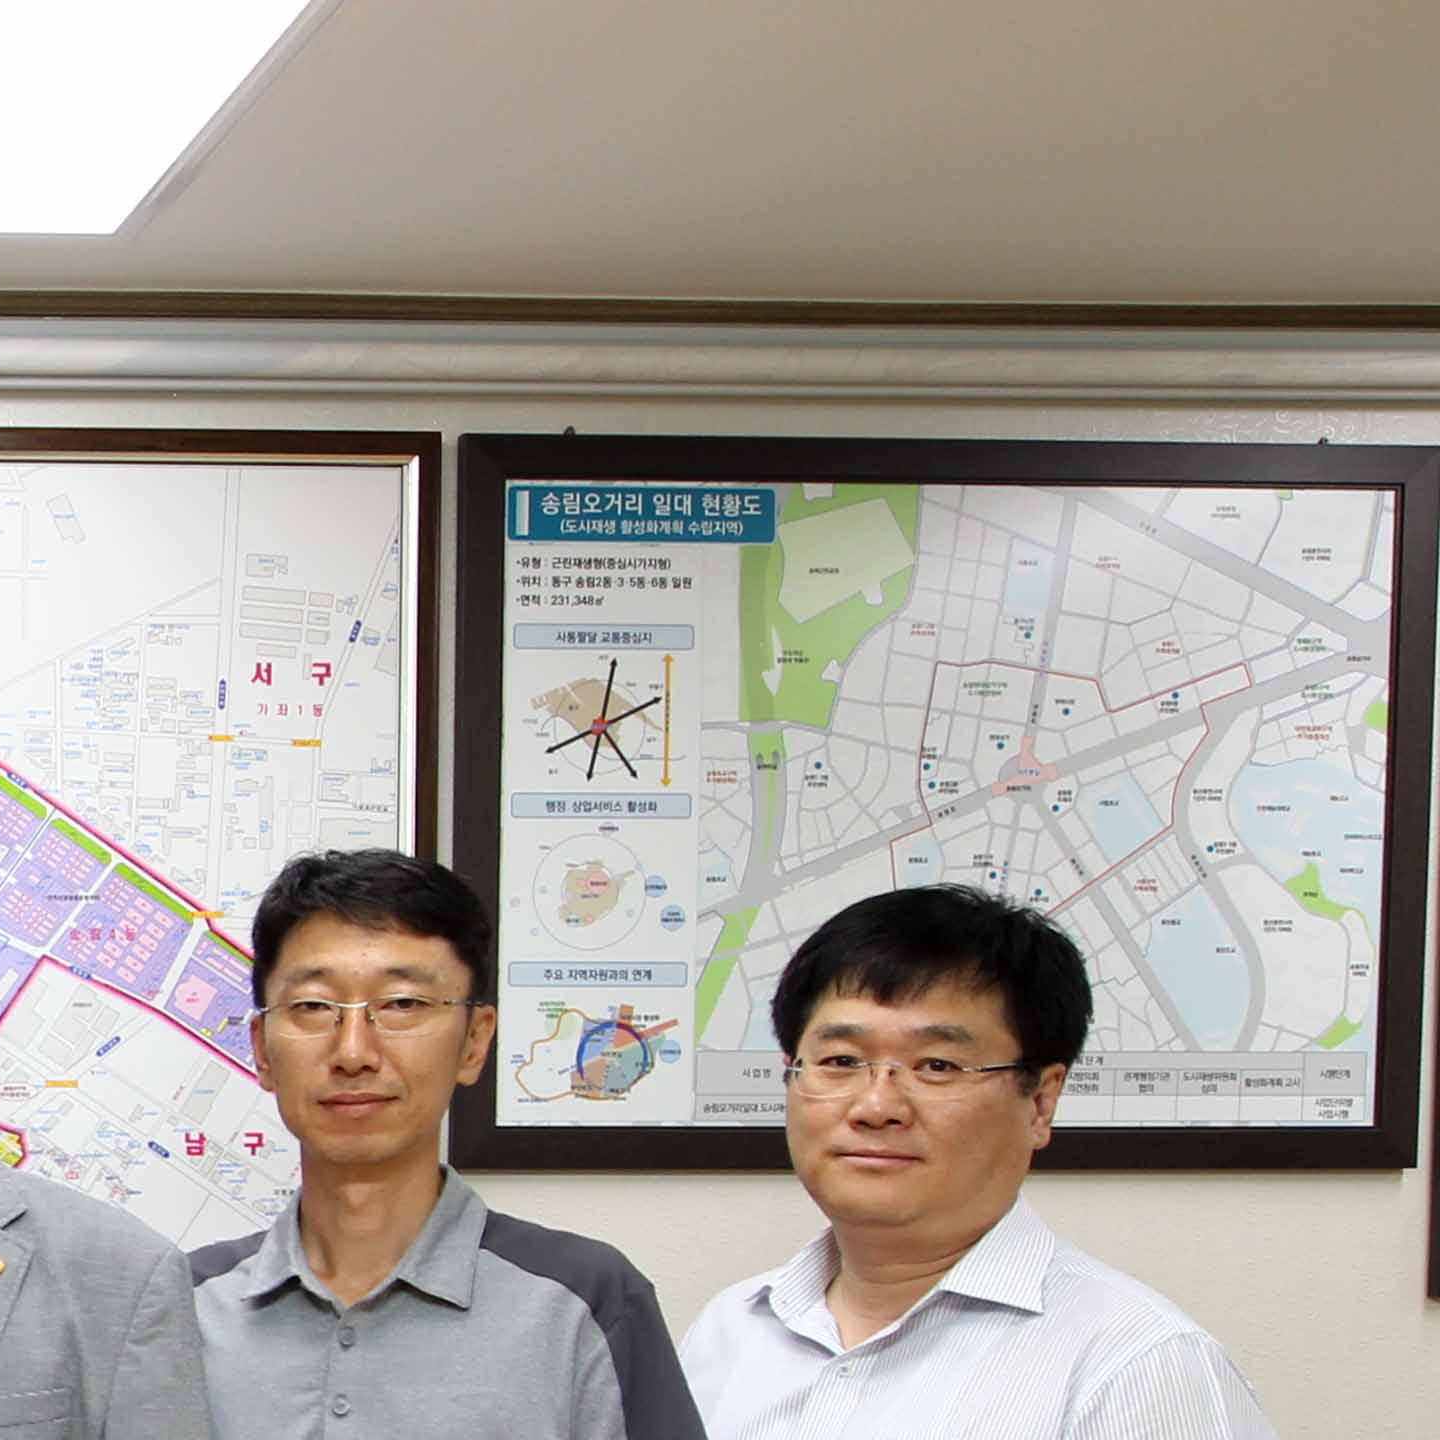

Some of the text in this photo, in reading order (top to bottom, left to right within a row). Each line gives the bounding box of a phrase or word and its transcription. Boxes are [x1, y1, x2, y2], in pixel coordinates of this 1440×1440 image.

[541, 493, 762, 517] 송림오거리 일대 현황도
[560, 519, 743, 536] (도시재생 활성화계획 수립지역)
[552, 577, 572, 589] 동구
[251, 662, 332, 687] 서구
[543, 969, 564, 982] 주요
[633, 969, 653, 982] 연계
[185, 1132, 264, 1157] 남구
